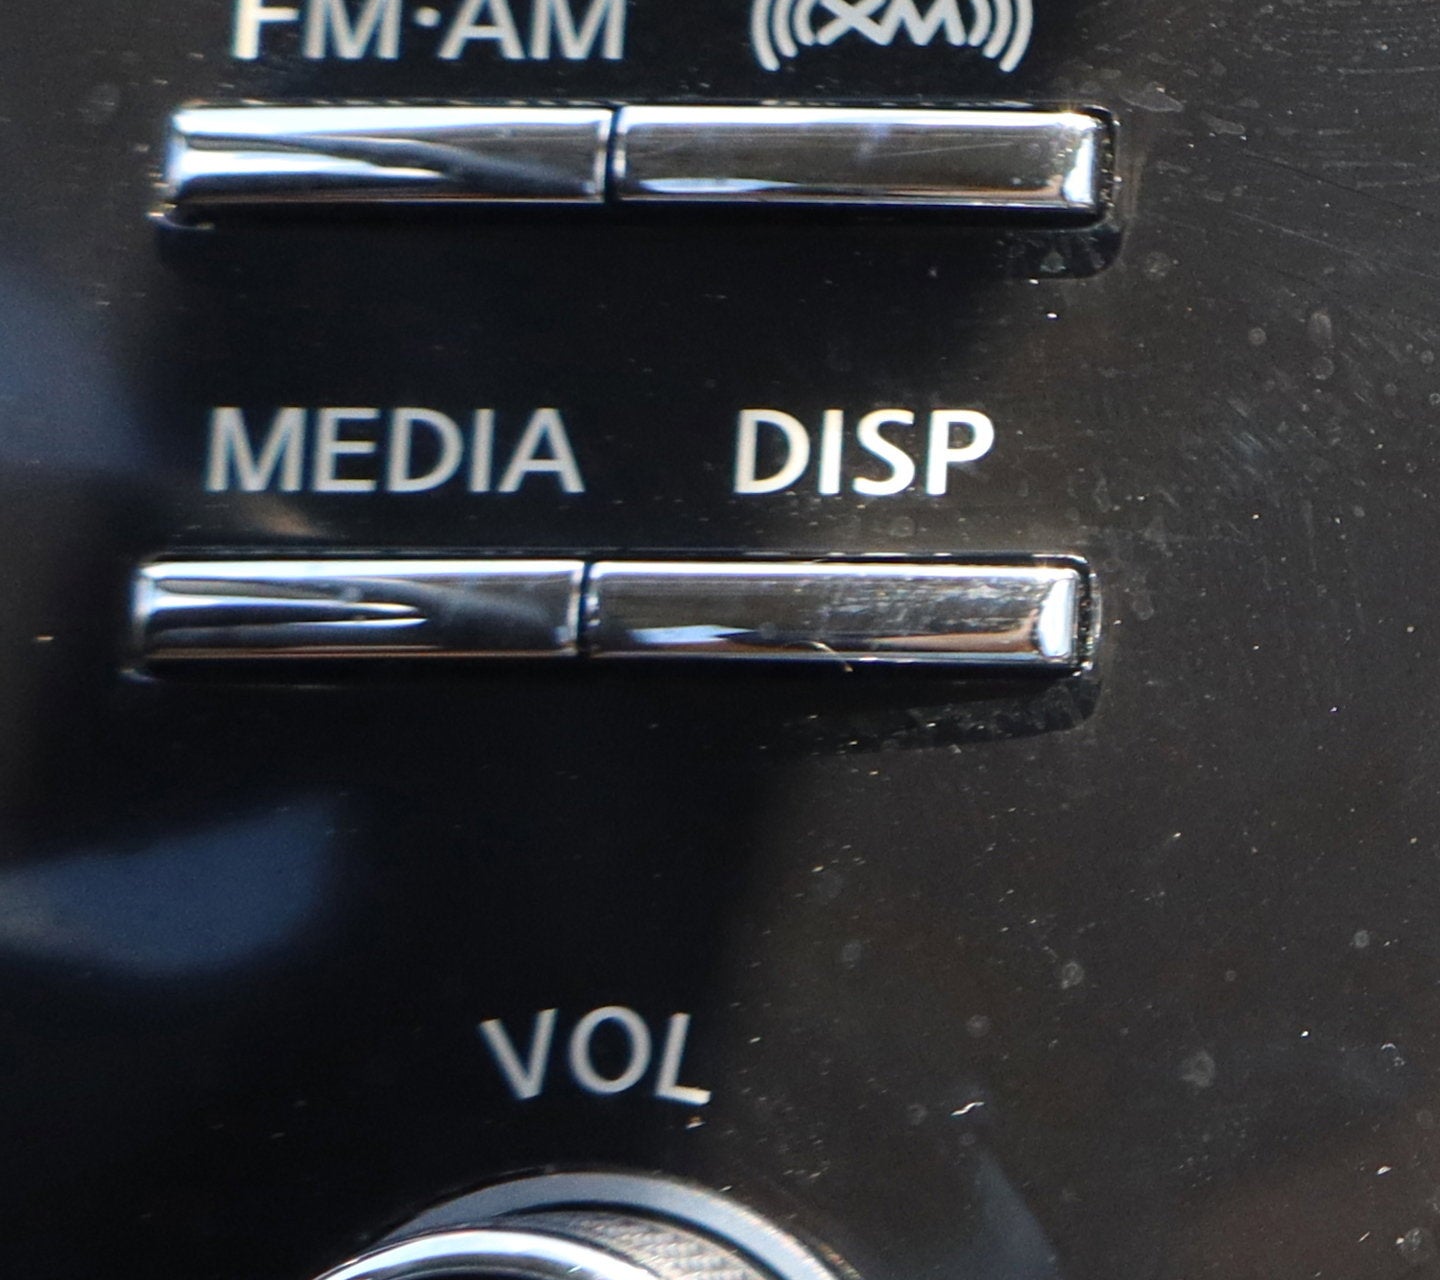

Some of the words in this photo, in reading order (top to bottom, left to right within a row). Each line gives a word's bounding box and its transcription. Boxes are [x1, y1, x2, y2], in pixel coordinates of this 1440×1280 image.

[204, 406, 586, 493] MEDIA
[733, 407, 995, 496] DISP
[480, 1005, 712, 1106] VOL
